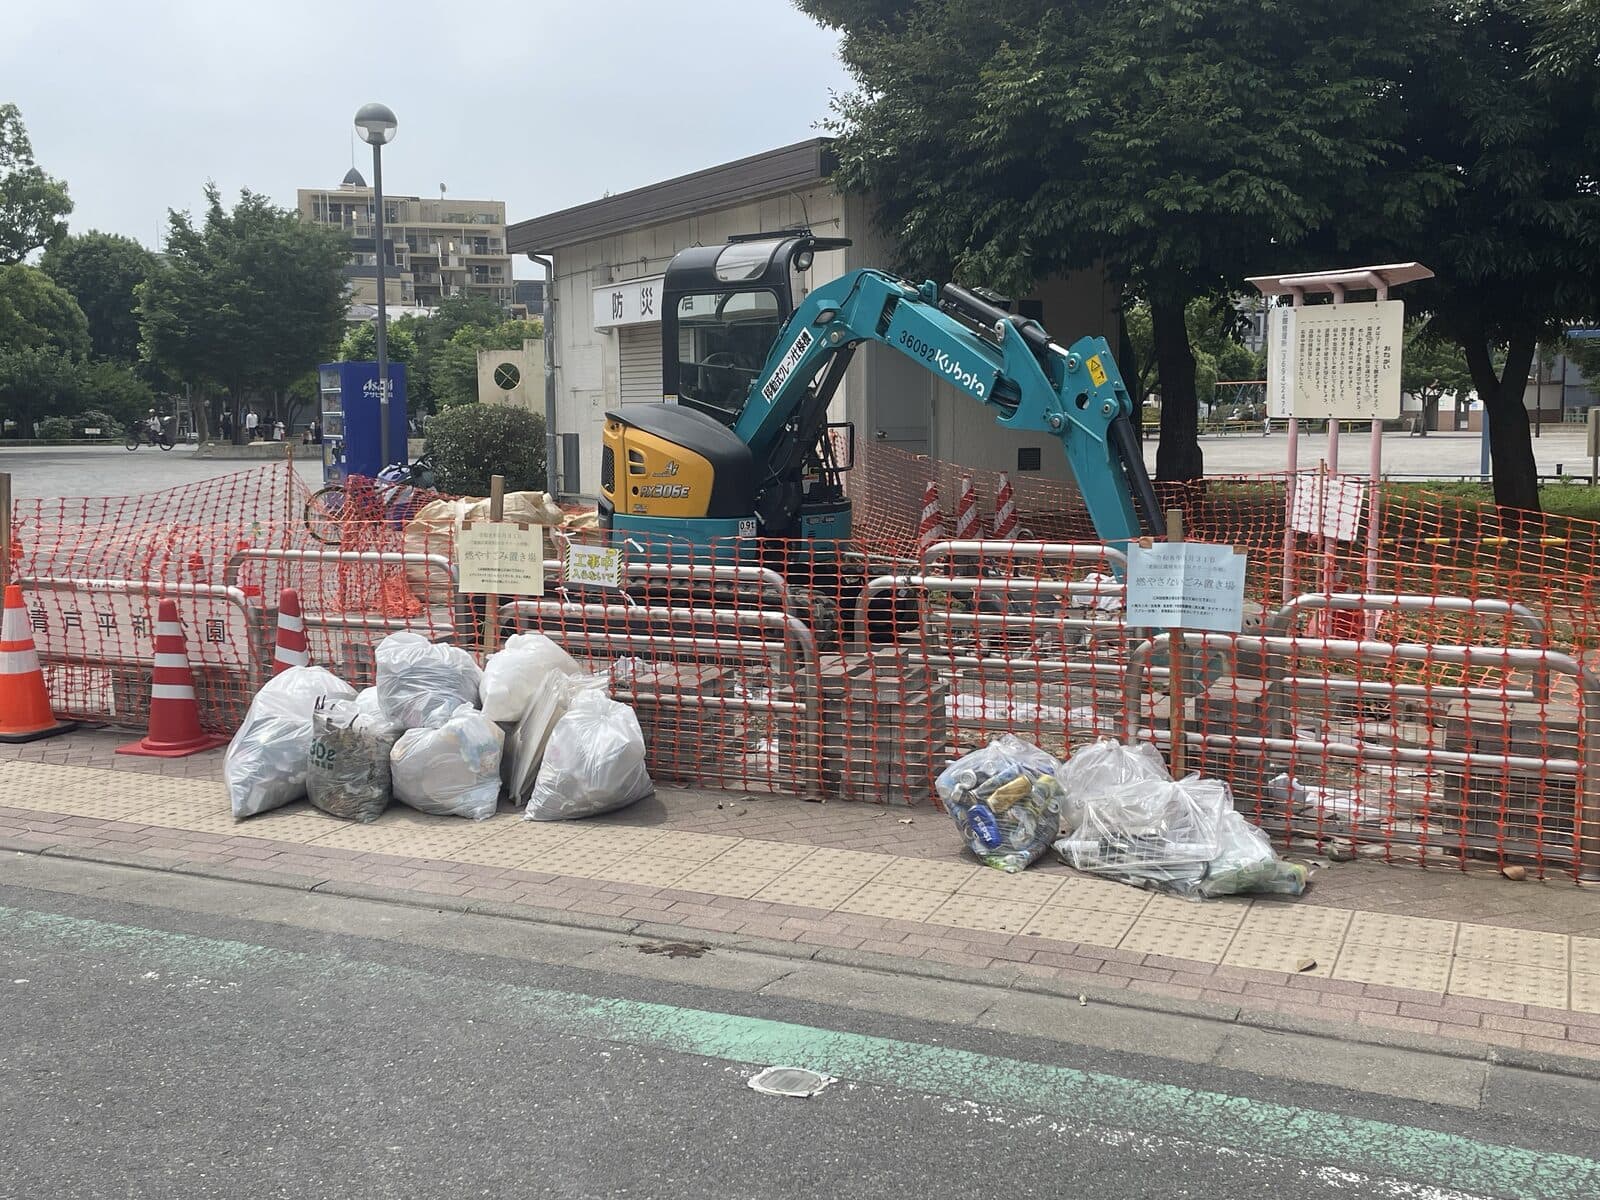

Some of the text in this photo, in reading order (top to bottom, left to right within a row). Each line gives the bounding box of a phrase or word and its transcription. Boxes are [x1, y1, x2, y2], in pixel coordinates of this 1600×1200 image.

[899, 330, 935, 363] 36092
[1383, 345, 1391, 370] おねがい
[935, 349, 985, 397] Kubota
[362, 378, 393, 391] Asi
[640, 484, 691, 498] RX306E
[464, 550, 537, 563] 燃やすごみ置き場
[573, 553, 614, 571] 工事中
[1136, 576, 1236, 591] 燃やさないごみ置き場
[30, 609, 225, 643] 青戸平和園
[974, 815, 992, 842] PEPSI
